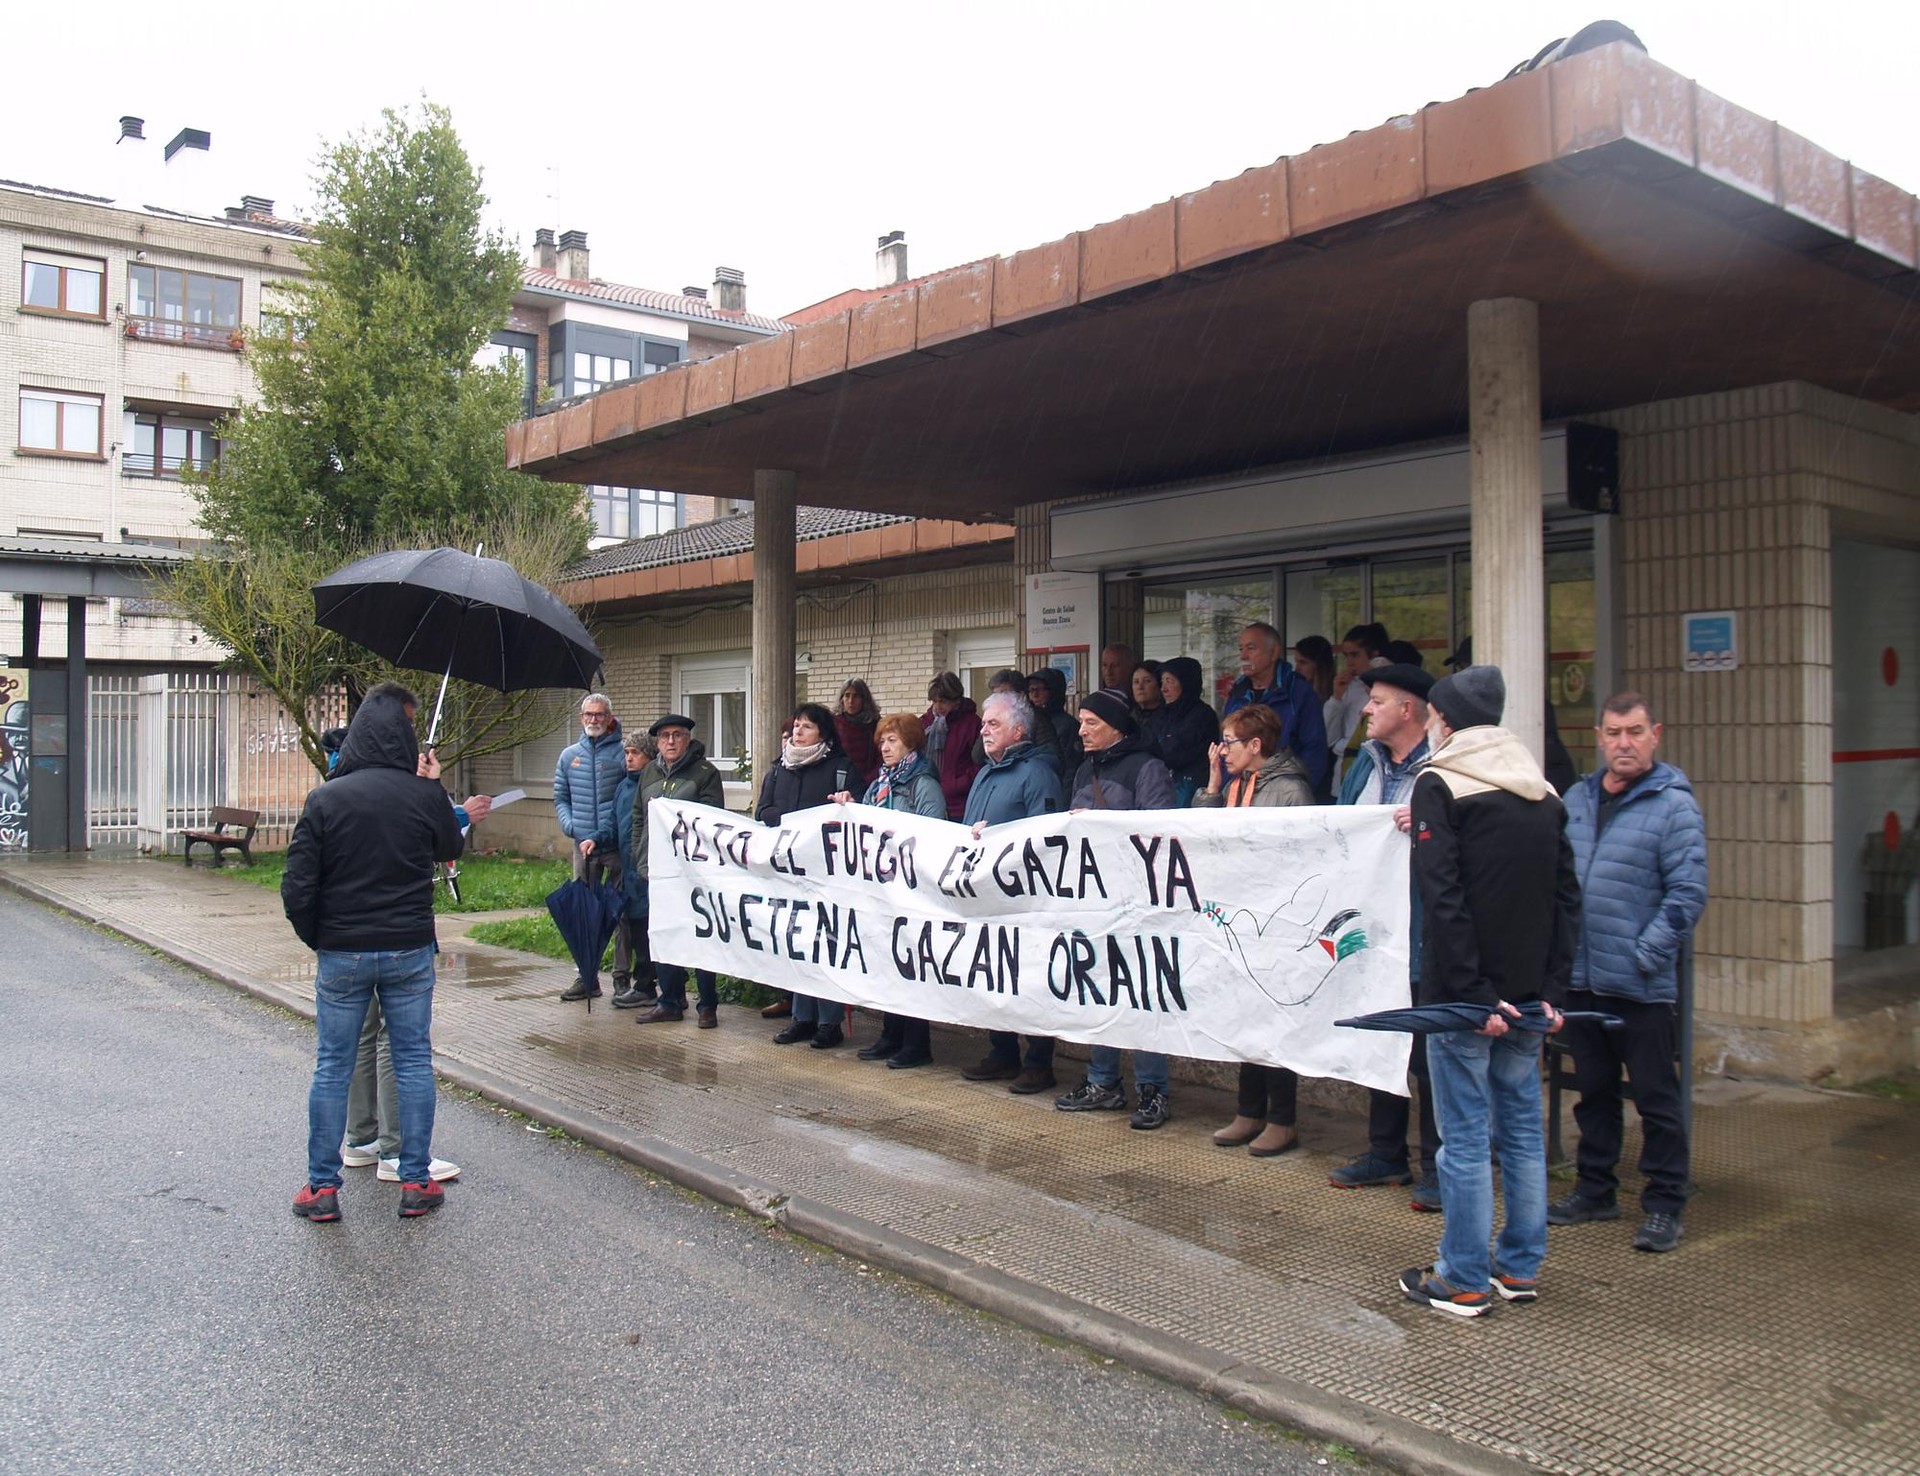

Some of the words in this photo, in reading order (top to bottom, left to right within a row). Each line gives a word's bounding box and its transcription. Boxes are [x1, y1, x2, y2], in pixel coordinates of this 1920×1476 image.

[671, 810, 752, 871] ALTO
[769, 829, 806, 876] EL
[821, 820, 917, 890] FUEGO
[938, 845, 985, 898] EN
[992, 835, 1108, 899] GAZA
[1129, 834, 1201, 912] YA
[690, 886, 868, 975] SU-ETENA
[892, 916, 1020, 997] GAZAN
[1048, 930, 1188, 1013] ORAIN
